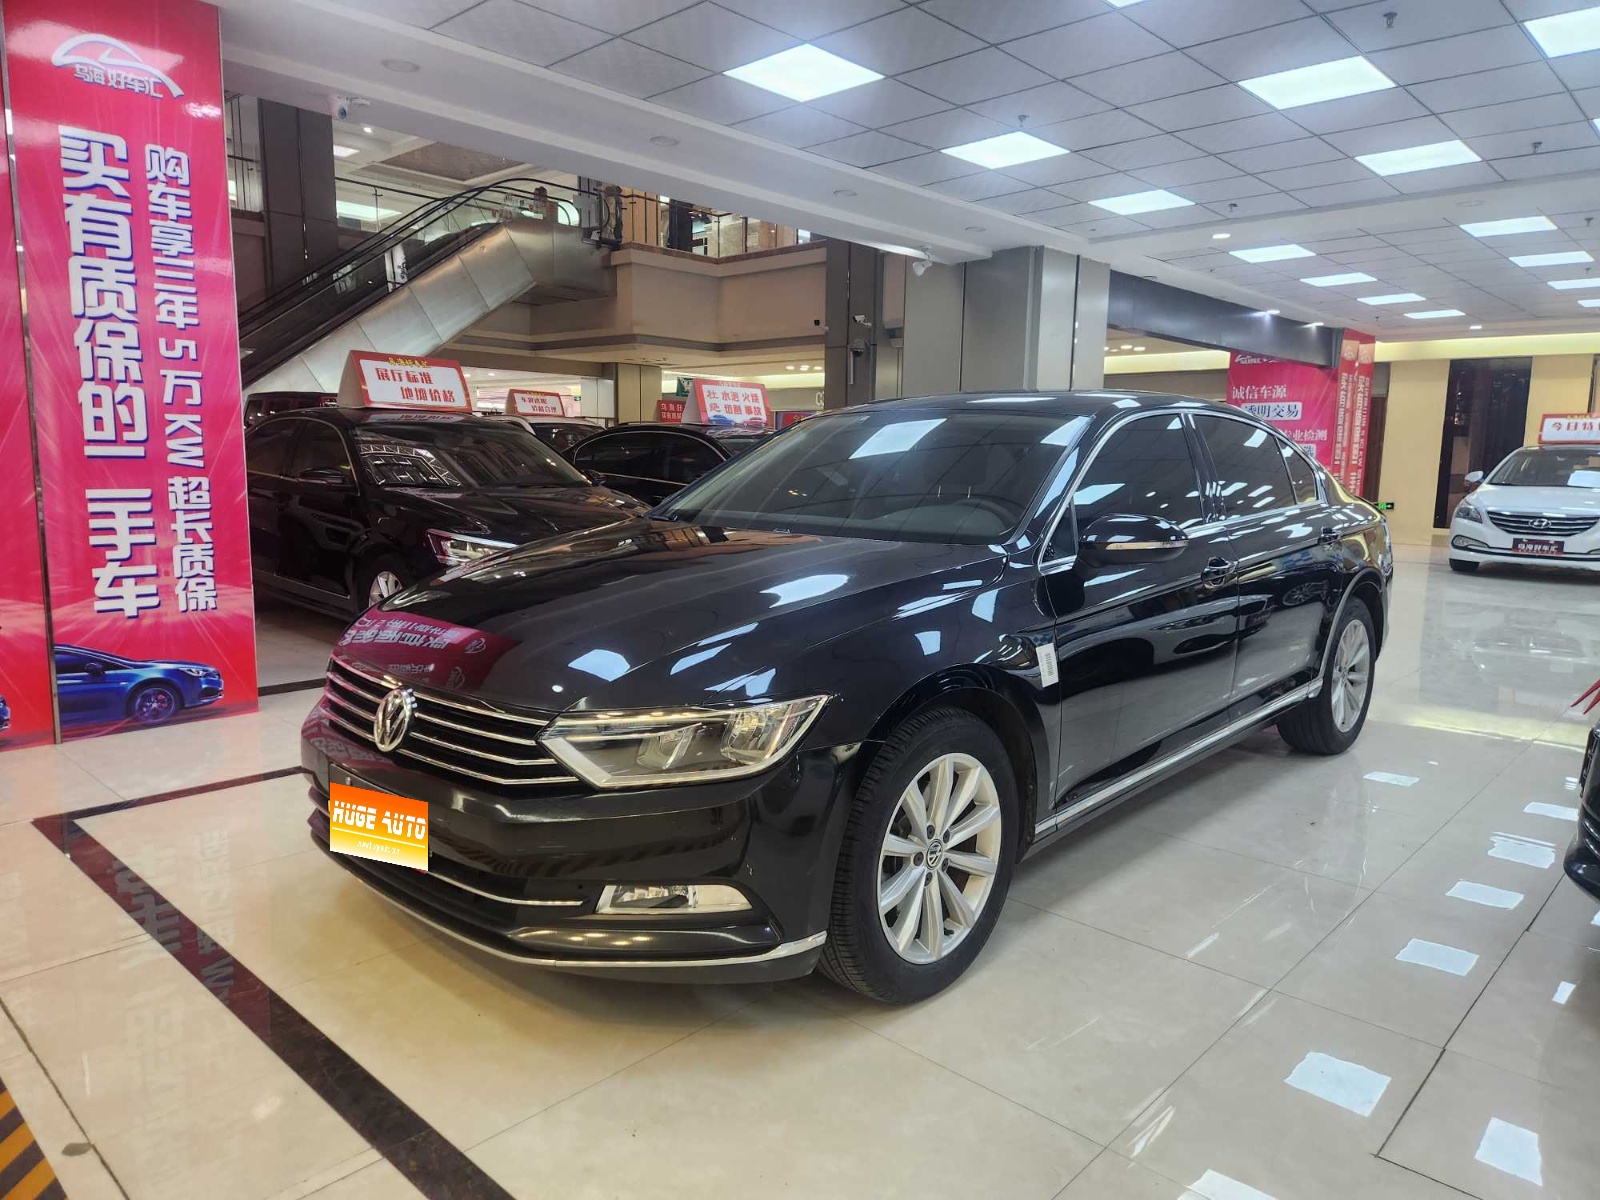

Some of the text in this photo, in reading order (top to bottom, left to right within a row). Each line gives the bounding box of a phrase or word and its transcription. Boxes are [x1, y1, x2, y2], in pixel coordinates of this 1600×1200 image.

[375, 367, 433, 385] 展厅标准
[400, 386, 455, 403] 地摊价格
[1232, 385, 1287, 400] 诚信车源
[1552, 421, 1600, 431] 今日特
